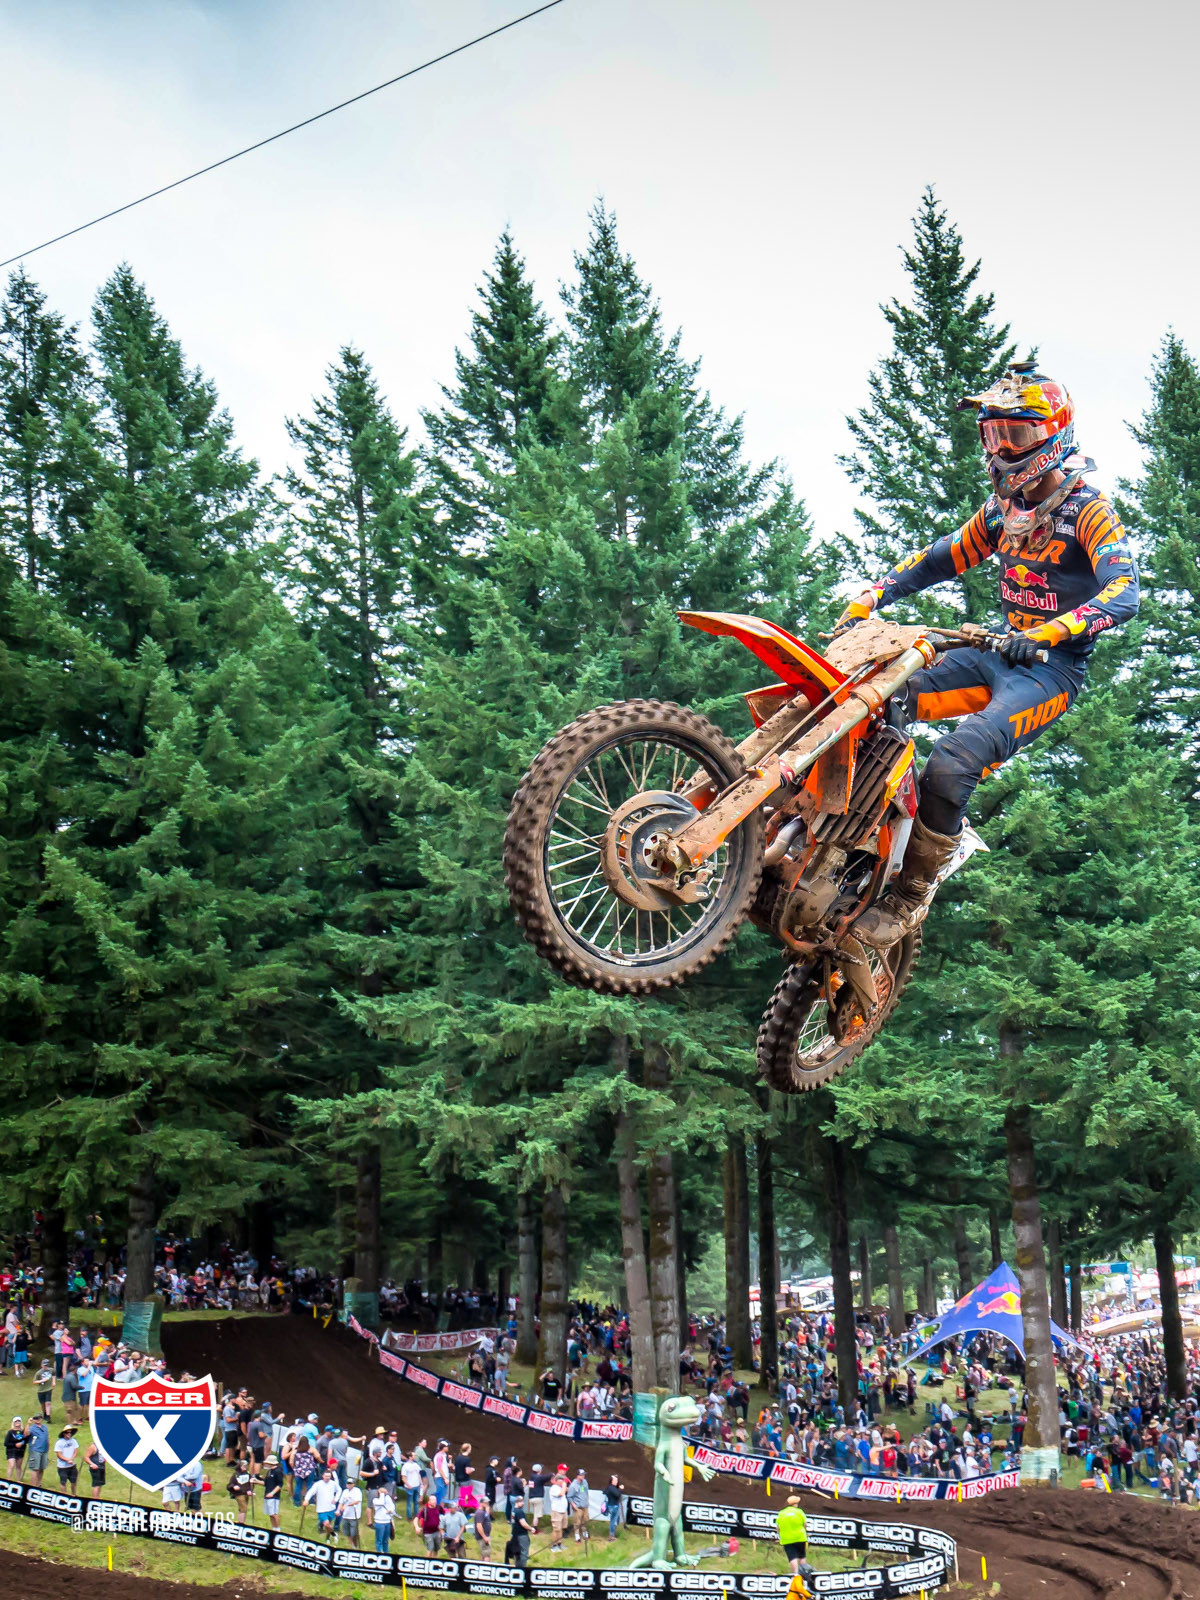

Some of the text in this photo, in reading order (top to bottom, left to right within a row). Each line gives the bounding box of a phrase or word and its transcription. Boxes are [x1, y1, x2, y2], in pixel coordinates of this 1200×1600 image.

[1007, 439, 1063, 491] Red Bull
[1001, 581, 1058, 611] Red Bull
[1008, 691, 1069, 739] THOR
[26, 1488, 83, 1513] GEICO
[30, 1508, 72, 1524] MOTORCYCLE
[685, 1506, 738, 1523] GEICO
[153, 1530, 197, 1545] MOTORCYCLE
[213, 1522, 269, 1546] GEICO
[862, 1523, 915, 1542] GEICO
[217, 1542, 259, 1557] MOTORCYCLE
[273, 1534, 331, 1562] GEICO
[278, 1554, 320, 1571] MOTORCYCLE
[334, 1551, 393, 1570] GEICO
[398, 1557, 459, 1577] GEICO
[888, 1556, 945, 1582] GEICO
[339, 1570, 383, 1583] MOTORCYCLE
[464, 1564, 525, 1584] GEICO
[531, 1569, 595, 1586] GEICO
[600, 1571, 665, 1588] GEICO
[670, 1573, 736, 1590] GEICO
[815, 1570, 882, 1590] GEICO
[405, 1577, 449, 1590] MOTORCYCLE
[470, 1585, 515, 1597] MOTORCYCLE
[899, 1576, 941, 1594] MOTORCYCLE
[538, 1590, 585, 1600] MOTORCYCLE
